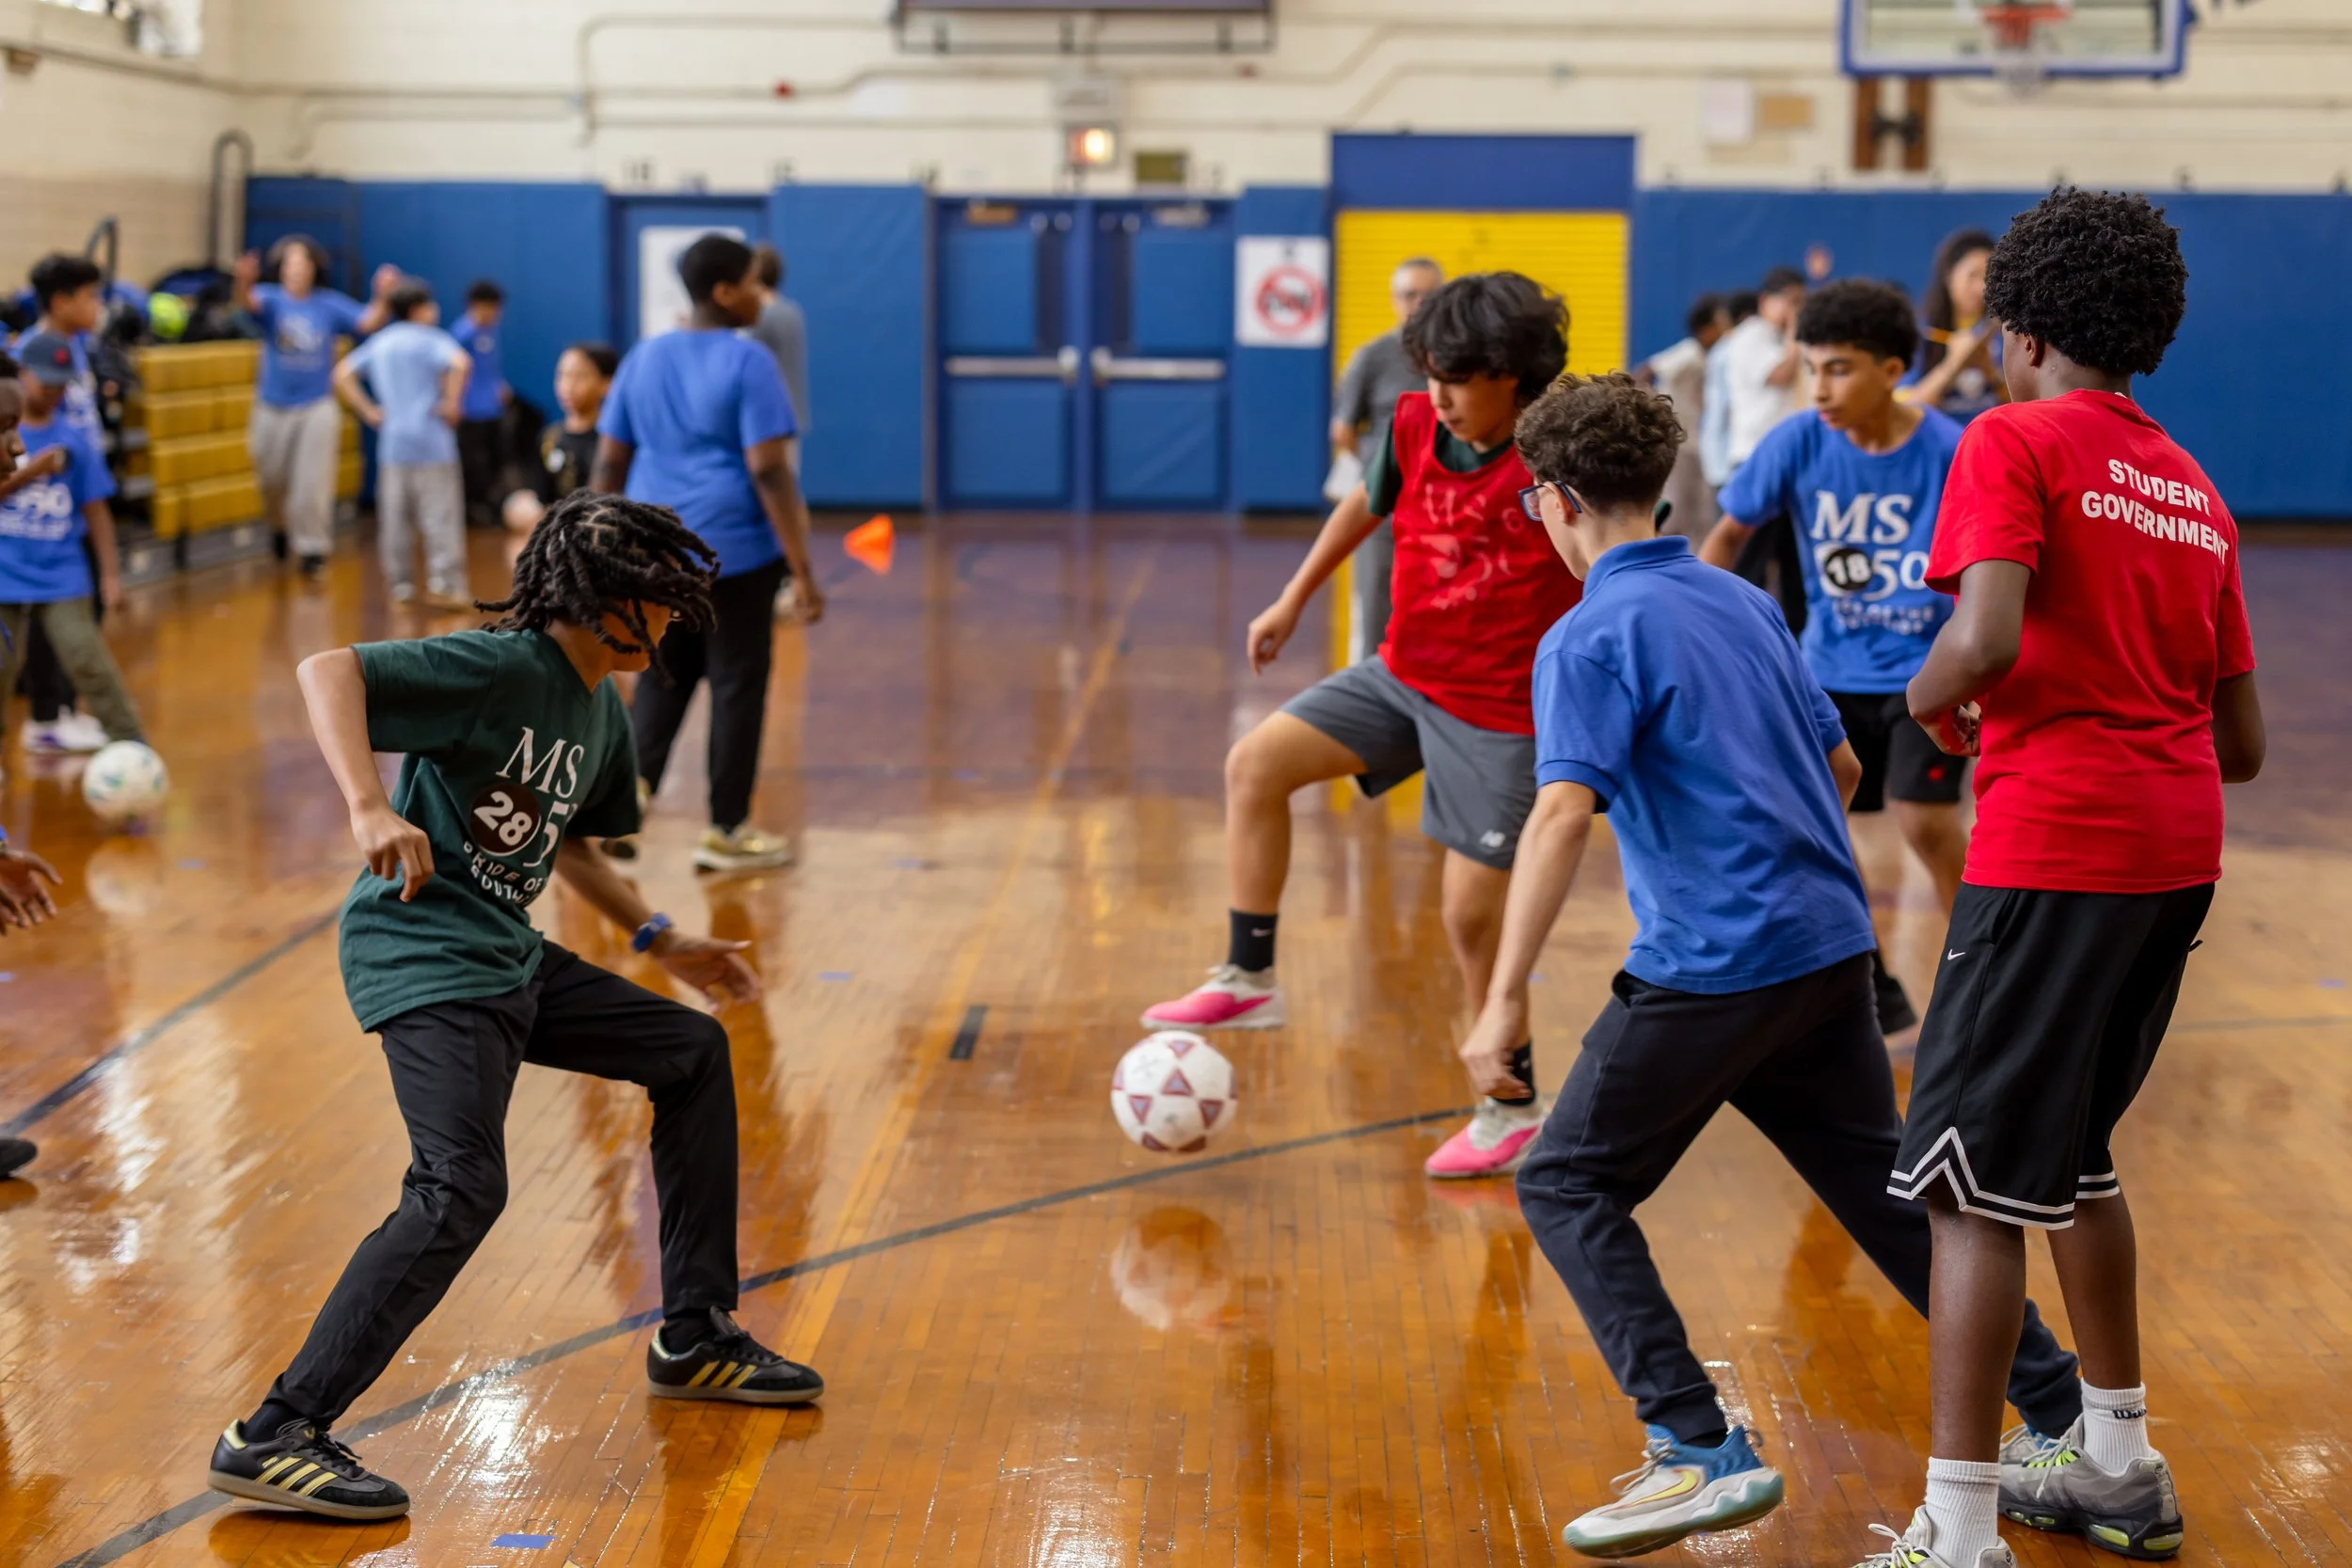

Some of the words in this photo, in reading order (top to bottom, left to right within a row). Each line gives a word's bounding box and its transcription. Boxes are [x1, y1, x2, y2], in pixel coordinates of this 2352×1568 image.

[2107, 458, 2211, 517] STUDENT
[1809, 489, 1913, 546] MS
[2081, 490, 2229, 565] GOVERNMENT
[495, 726, 585, 799] MS
[473, 790, 532, 847] 28
